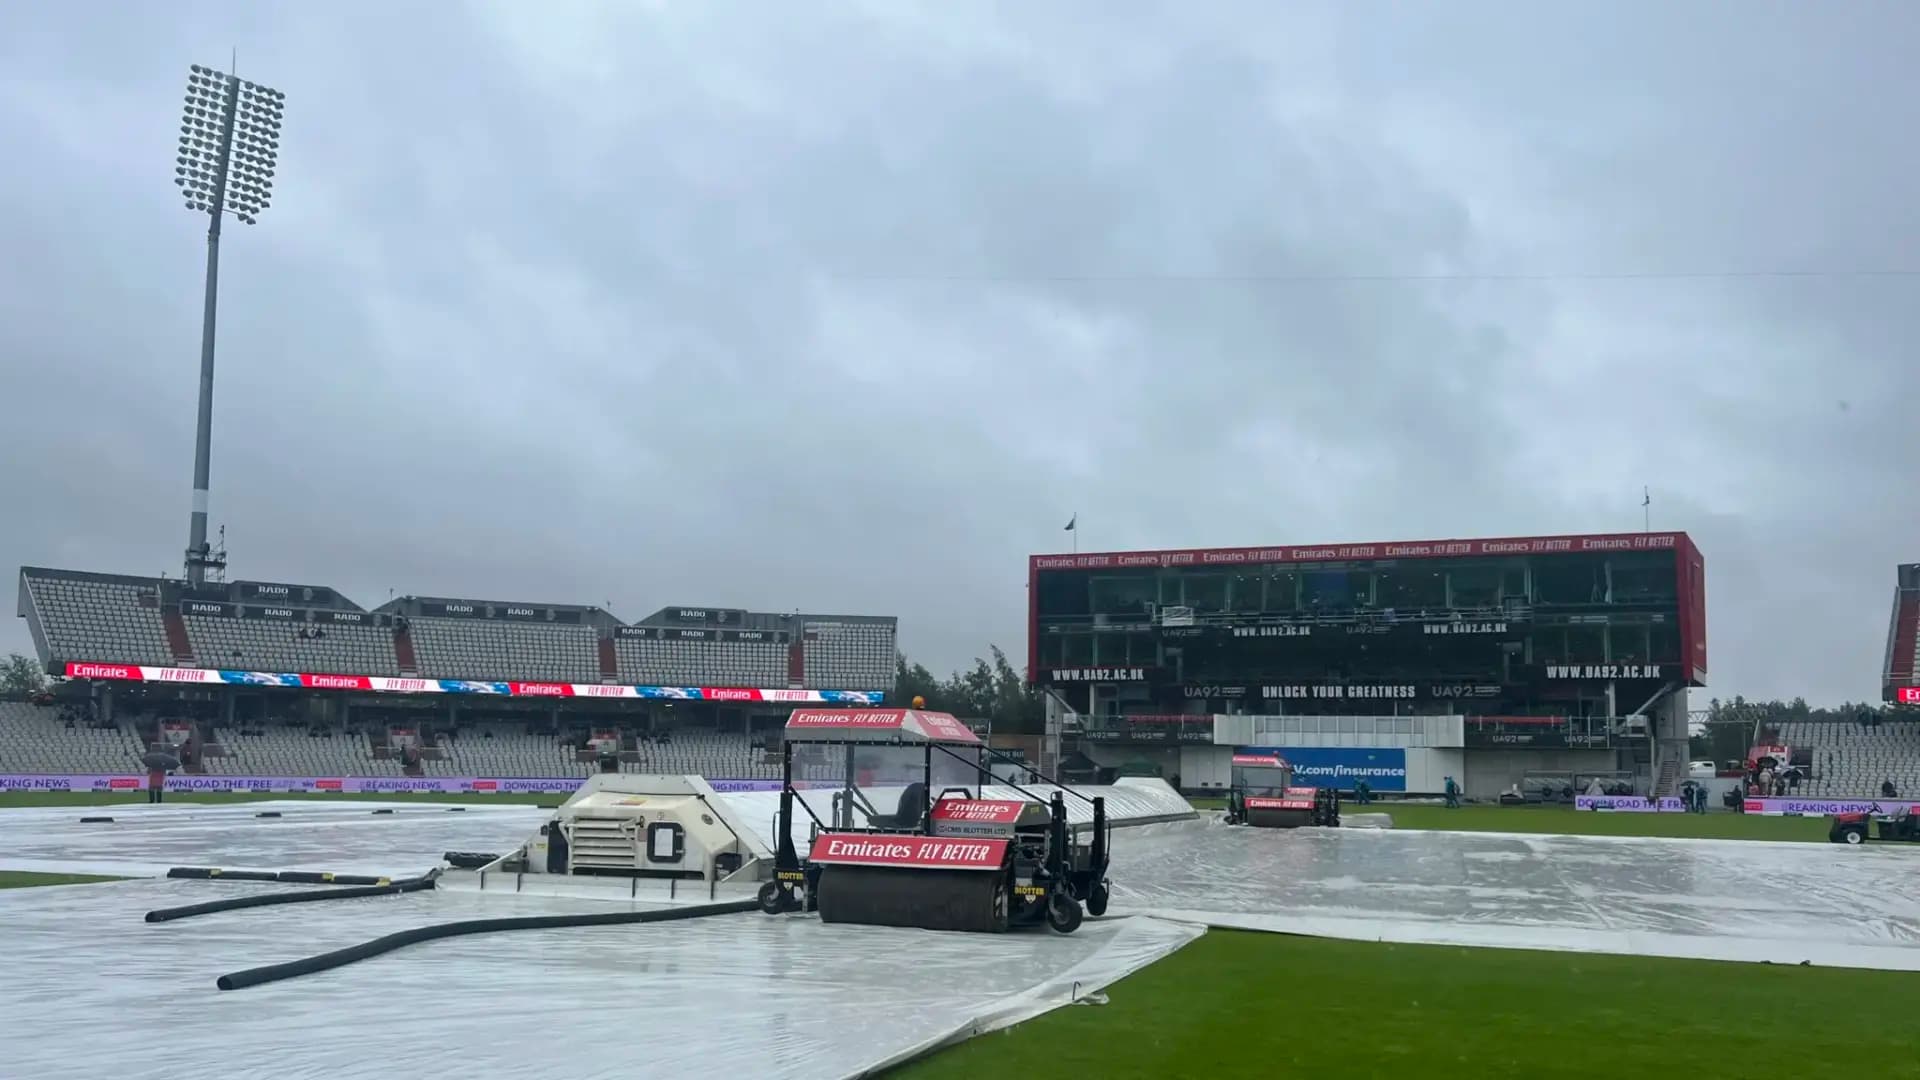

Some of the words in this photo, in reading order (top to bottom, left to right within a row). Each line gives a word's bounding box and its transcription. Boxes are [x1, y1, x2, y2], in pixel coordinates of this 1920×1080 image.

[1482, 543, 1528, 552] Emirates
[1583, 538, 1631, 549] Emirates
[1293, 549, 1335, 559] Emirates
[1385, 546, 1430, 556] Emirates
[1118, 555, 1158, 564] Emirates
[1203, 552, 1244, 562] Emirates
[258, 586, 289, 595] RADO
[192, 604, 221, 612] RADO
[264, 608, 293, 617] RADO
[446, 605, 473, 613] RADO
[507, 608, 534, 616] RADO
[680, 610, 706, 618] RADO
[73, 664, 128, 678] Emirates
[160, 670, 174, 679] FLY
[176, 670, 206, 681] BETTER
[1547, 665, 1660, 679] WWW.UA92.AC.UK
[312, 676, 358, 688] Emirates
[519, 683, 562, 695] Emirates
[711, 689, 751, 699] Emirates
[1184, 687, 1221, 697] UA92
[1262, 686, 1307, 698] UNLOCK
[1313, 686, 1343, 698] YOUR
[1349, 686, 1416, 698] GREATNESS
[1432, 686, 1473, 697] UA92
[798, 714, 849, 723] Emirates
[853, 714, 866, 723] FLY
[867, 714, 897, 723] BETTER
[1291, 764, 1405, 777] V.com/insurance
[35, 779, 70, 788] NEWS
[223, 780, 244, 788] THE
[249, 780, 272, 788] FREE
[504, 782, 562, 790] DOWNLOAD
[945, 803, 1009, 812] Emirates
[828, 841, 911, 858] Emirates
[917, 843, 940, 859] FLY
[941, 845, 989, 861] BETTER
